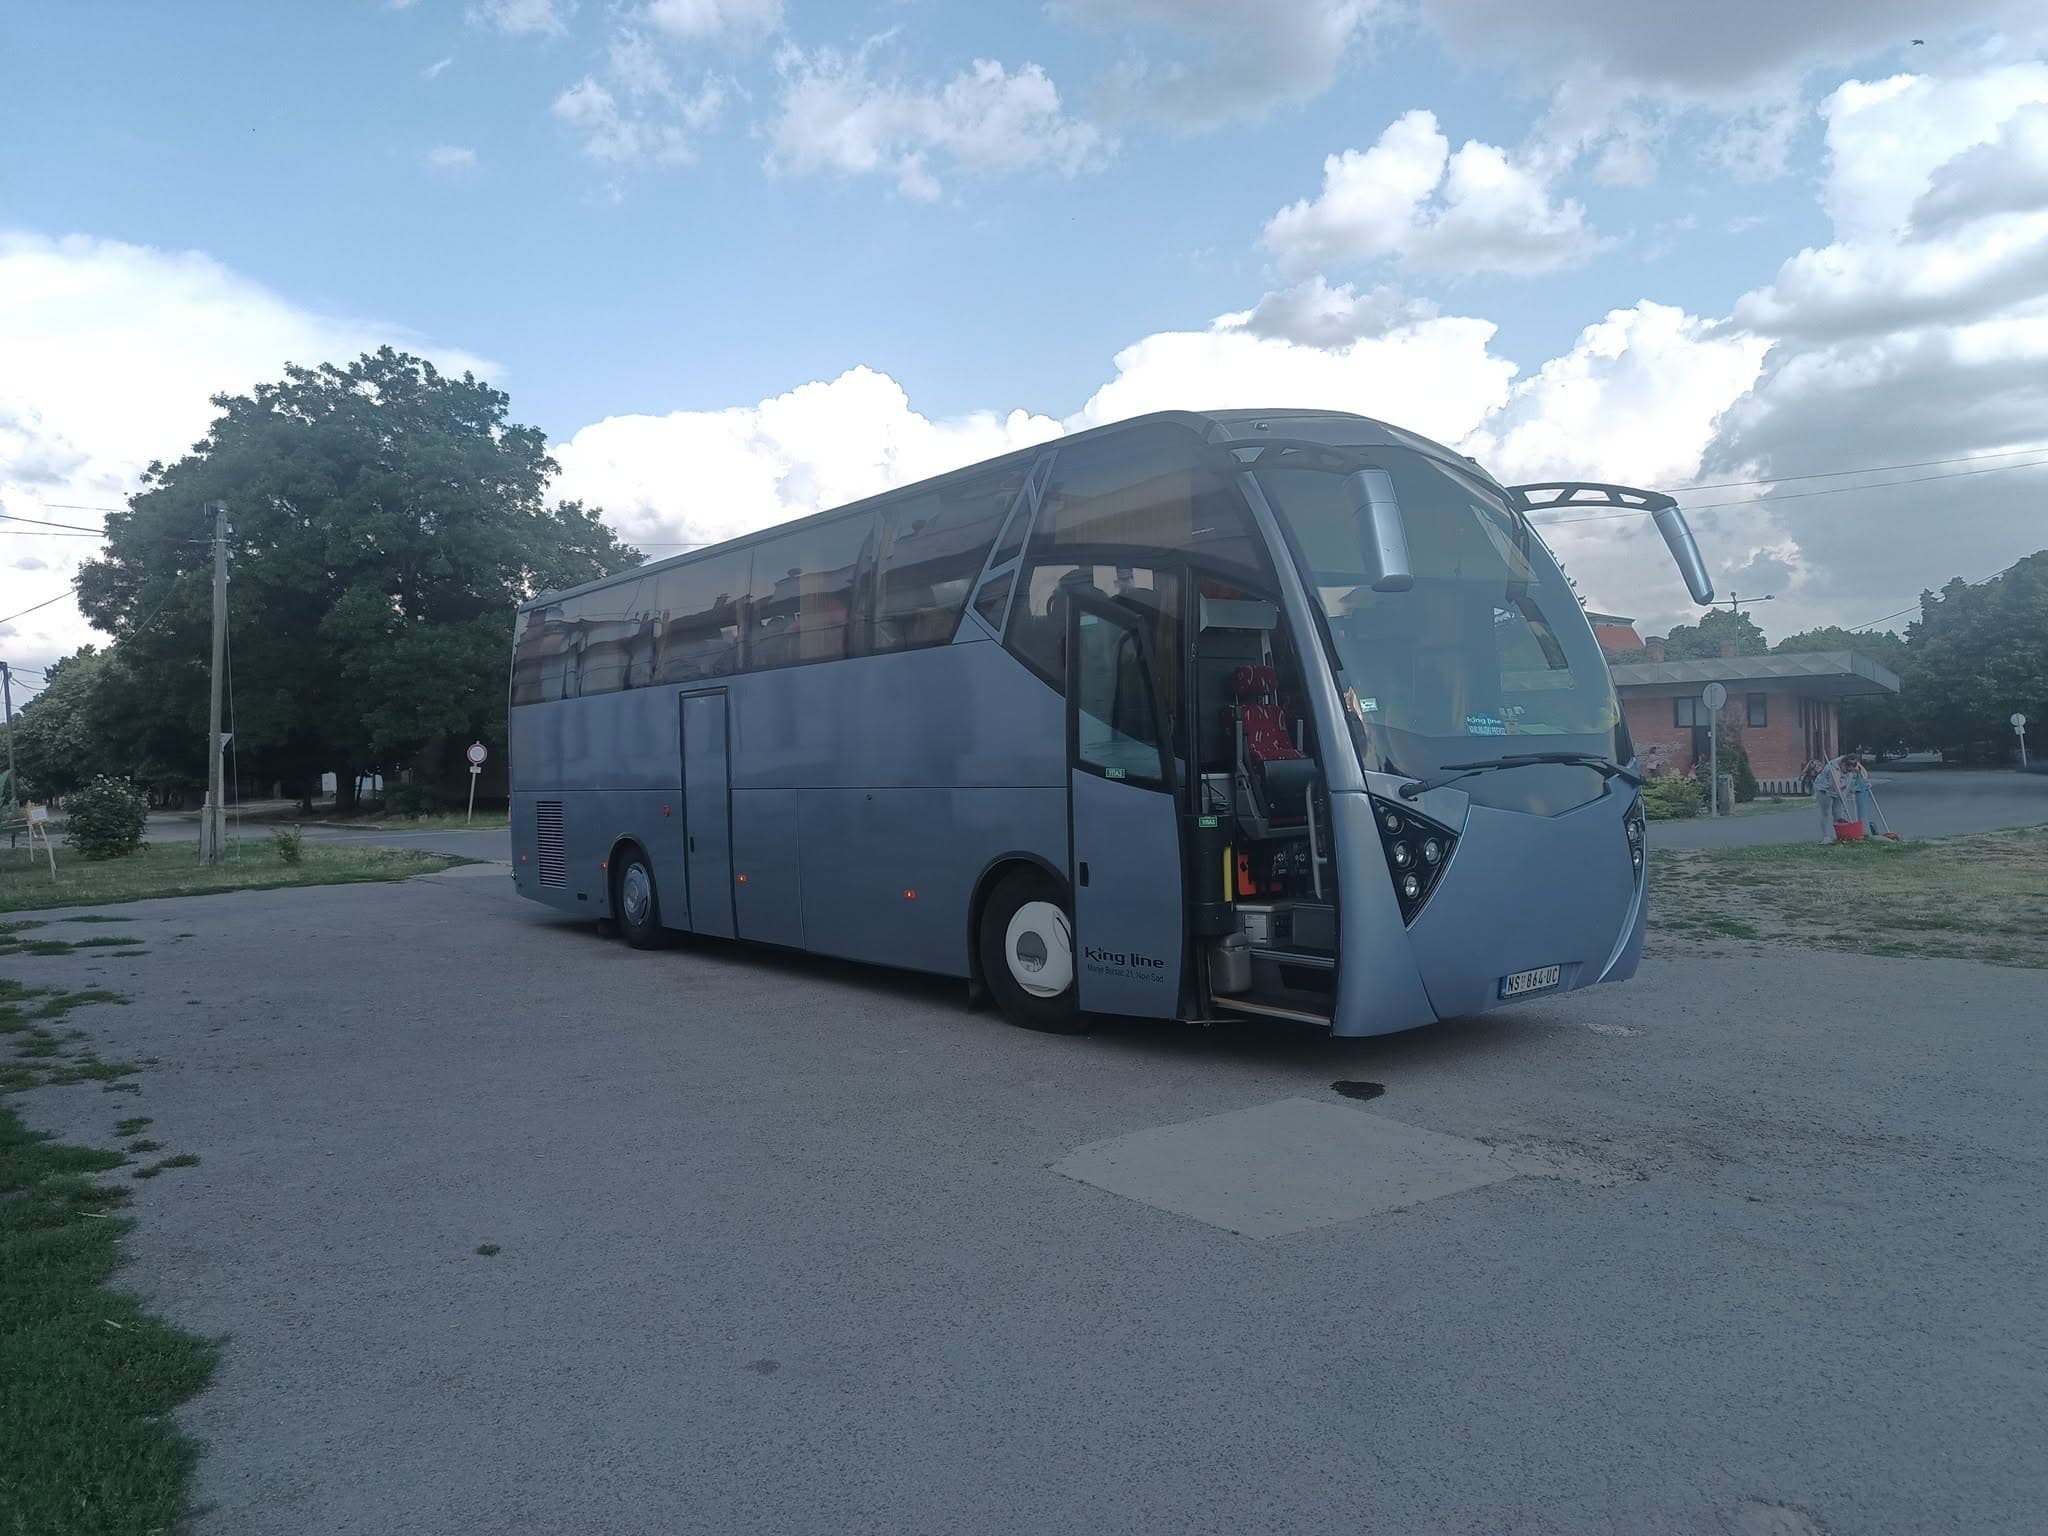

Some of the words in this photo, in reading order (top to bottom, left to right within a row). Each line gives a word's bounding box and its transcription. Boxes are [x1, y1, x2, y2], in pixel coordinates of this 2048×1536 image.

[1085, 946, 1125, 966] king
[1130, 953, 1164, 968] line
[1508, 975, 1520, 992] NS
